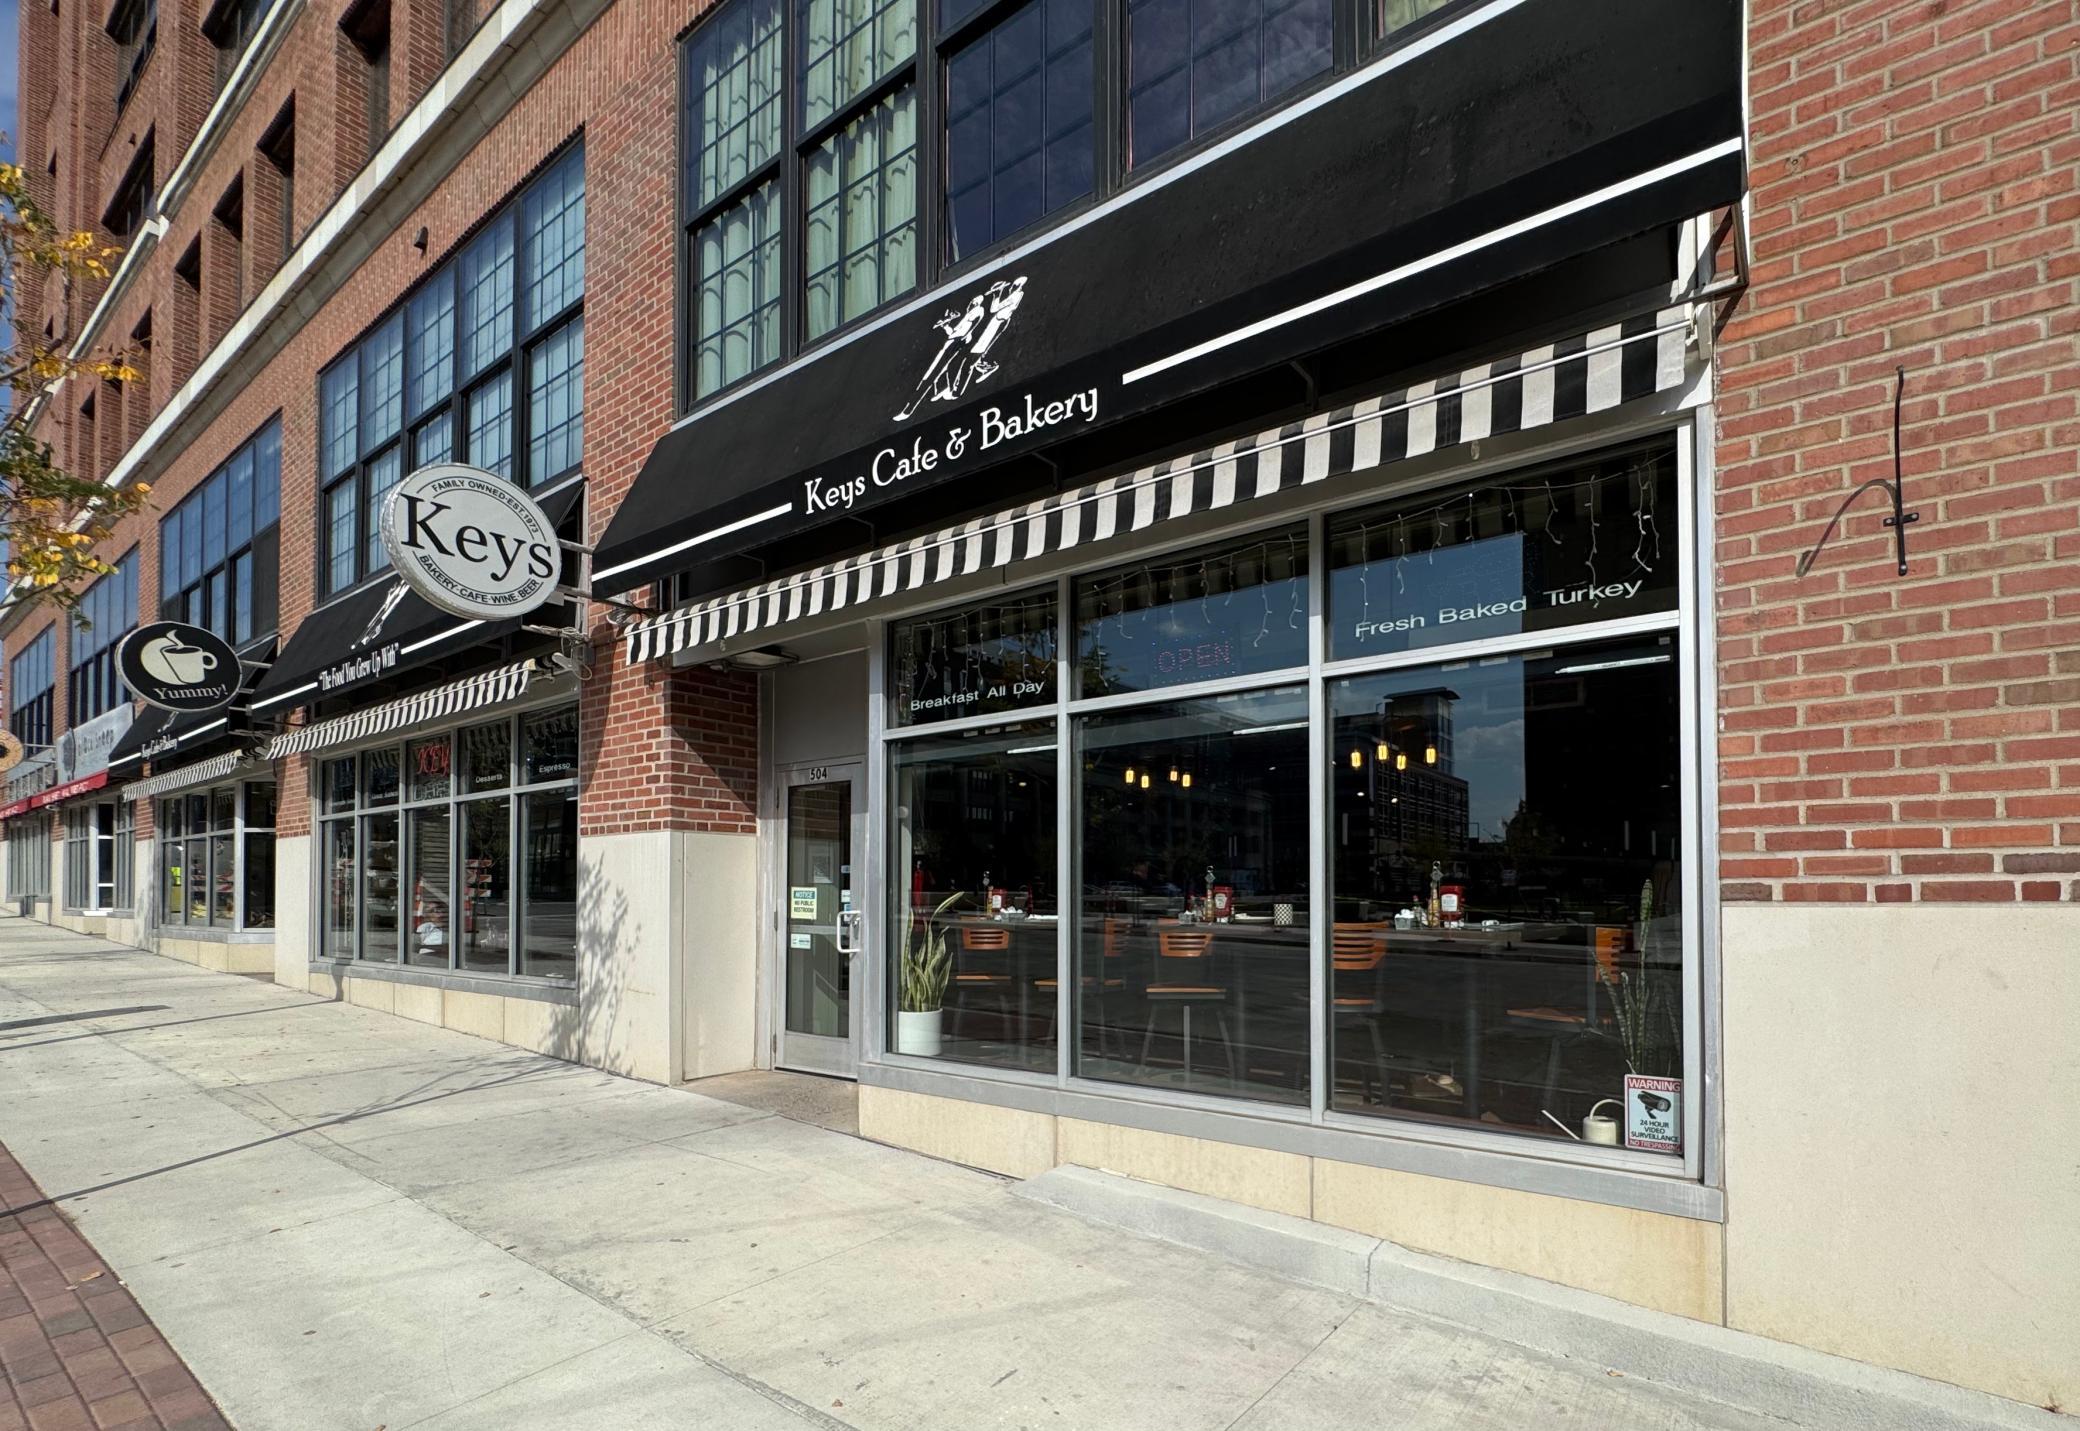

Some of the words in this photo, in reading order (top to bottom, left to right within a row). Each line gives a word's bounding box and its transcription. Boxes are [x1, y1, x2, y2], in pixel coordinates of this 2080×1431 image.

[805, 477, 865, 515] Keys
[872, 436, 938, 487] Cafe
[945, 428, 971, 459] &
[979, 387, 1098, 451] Bakery
[431, 480, 465, 492] FAMILY
[468, 481, 506, 500] OWNED
[400, 494, 553, 582] Keys
[419, 555, 457, 589] BAKERY
[459, 588, 489, 604] CAFE
[490, 594, 518, 604] WINE
[519, 579, 540, 598] BEER
[1355, 614, 1425, 637] Fresh
[1438, 596, 1527, 624] Baked
[1542, 580, 1643, 607] Turkey
[1156, 642, 1230, 674] OPEN
[332, 663, 344, 688] Food
[345, 661, 356, 682] You
[356, 657, 371, 678] Grew
[371, 650, 381, 678] Up
[153, 683, 228, 700] Yummy!
[910, 690, 979, 712] Breakfast
[986, 686, 1006, 699] All
[1013, 681, 1045, 697] Day
[539, 763, 571, 773] Espresso
[810, 767, 827, 780] 504
[475, 773, 503, 783] Desserts
[795, 891, 814, 899] NOTICE
[1628, 1078, 1681, 1092] WARNING
[1644, 1126, 1665, 1134] VIDEO
[1649, 1120, 1669, 1128] HOUR
[1631, 1130, 1679, 1143] SURVEILLANCE
[1640, 1141, 1680, 1152] TRESPASSING
